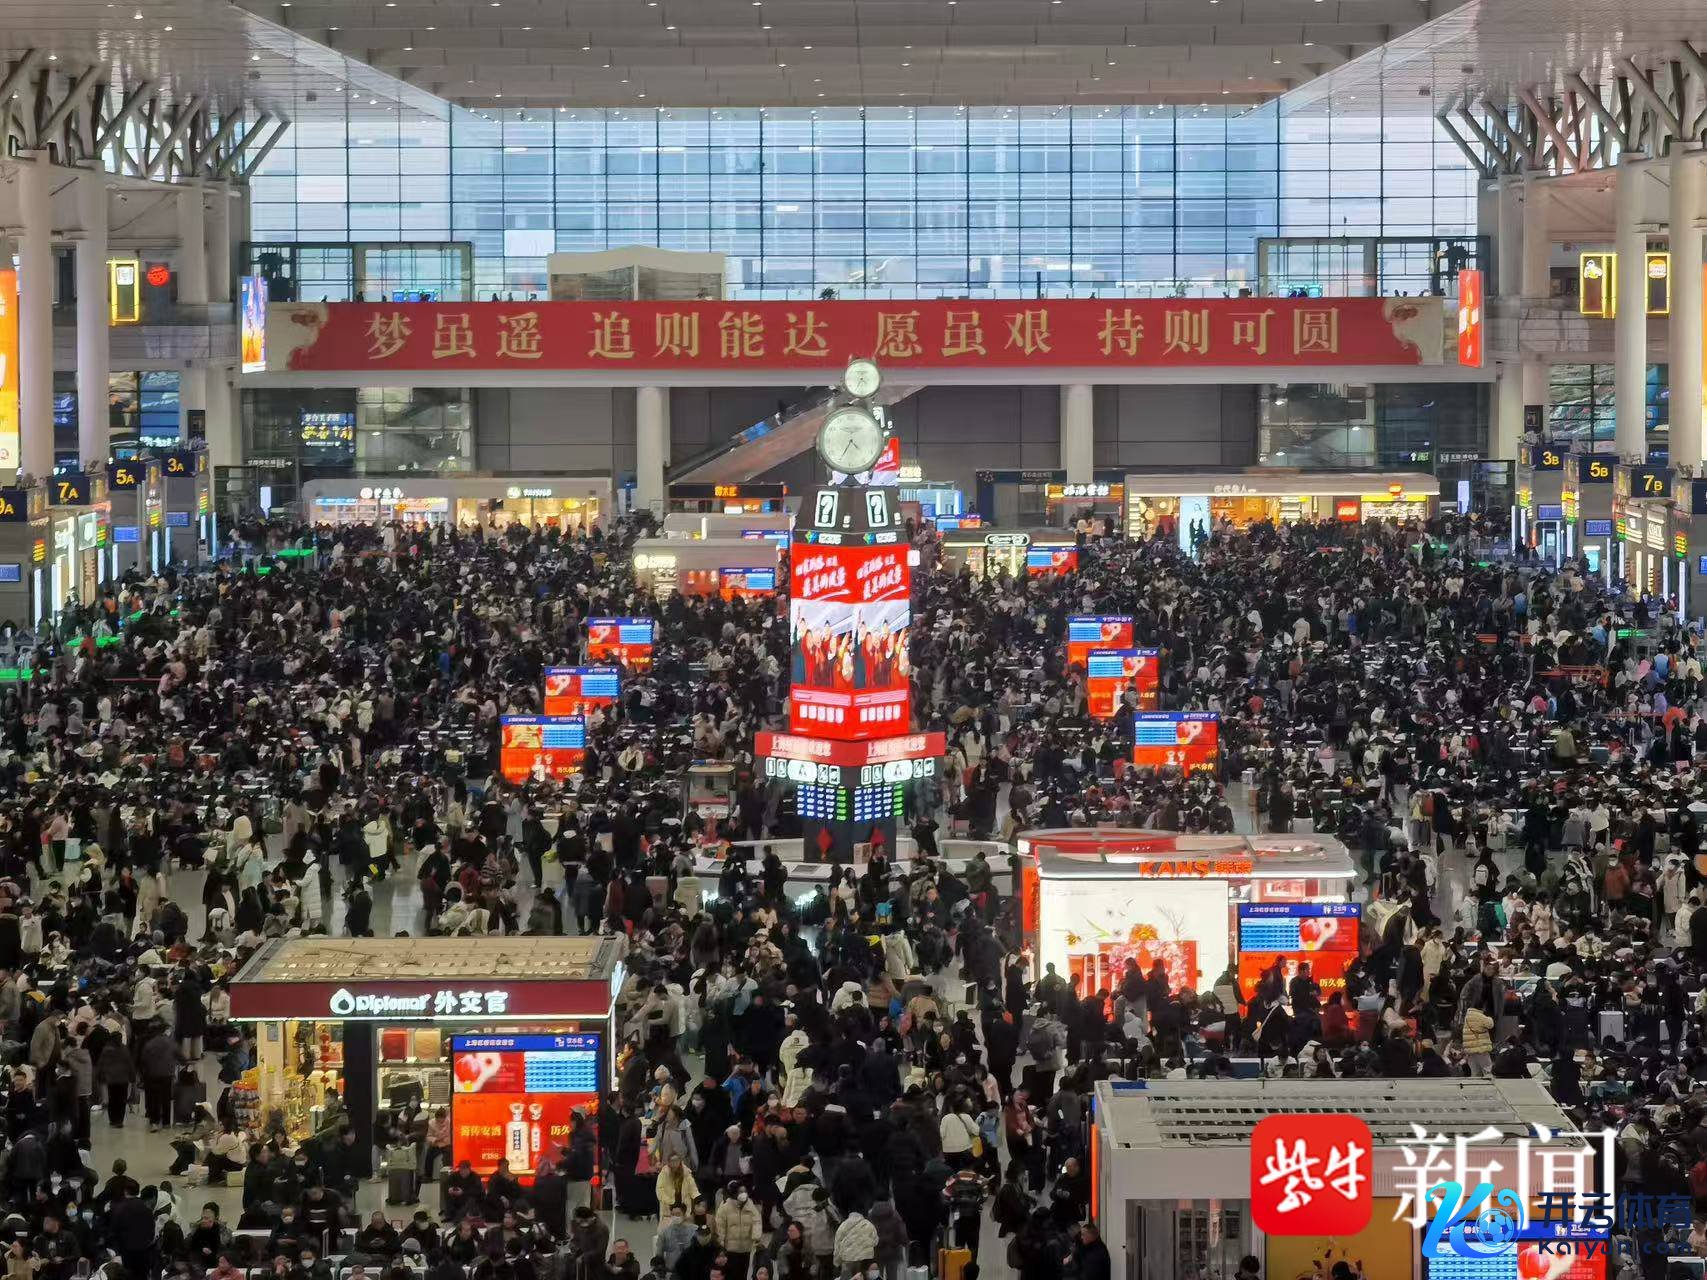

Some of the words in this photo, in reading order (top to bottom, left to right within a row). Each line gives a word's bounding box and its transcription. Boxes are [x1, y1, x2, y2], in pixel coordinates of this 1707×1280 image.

[364, 311, 544, 360] 梦虽遥
[586, 310, 831, 359] 追则能达
[874, 308, 1054, 358] 愿虽艰
[1096, 307, 1340, 357] 持则可圆
[167, 457, 185, 472] 3A
[1541, 451, 1561, 466] 3B
[115, 468, 136, 485] 5A
[1589, 461, 1610, 479] 5B
[57, 482, 80, 500] 7A
[1642, 474, 1664, 492] 7B
[1139, 860, 1211, 877] KANS
[433, 990, 509, 1014] 外交官
